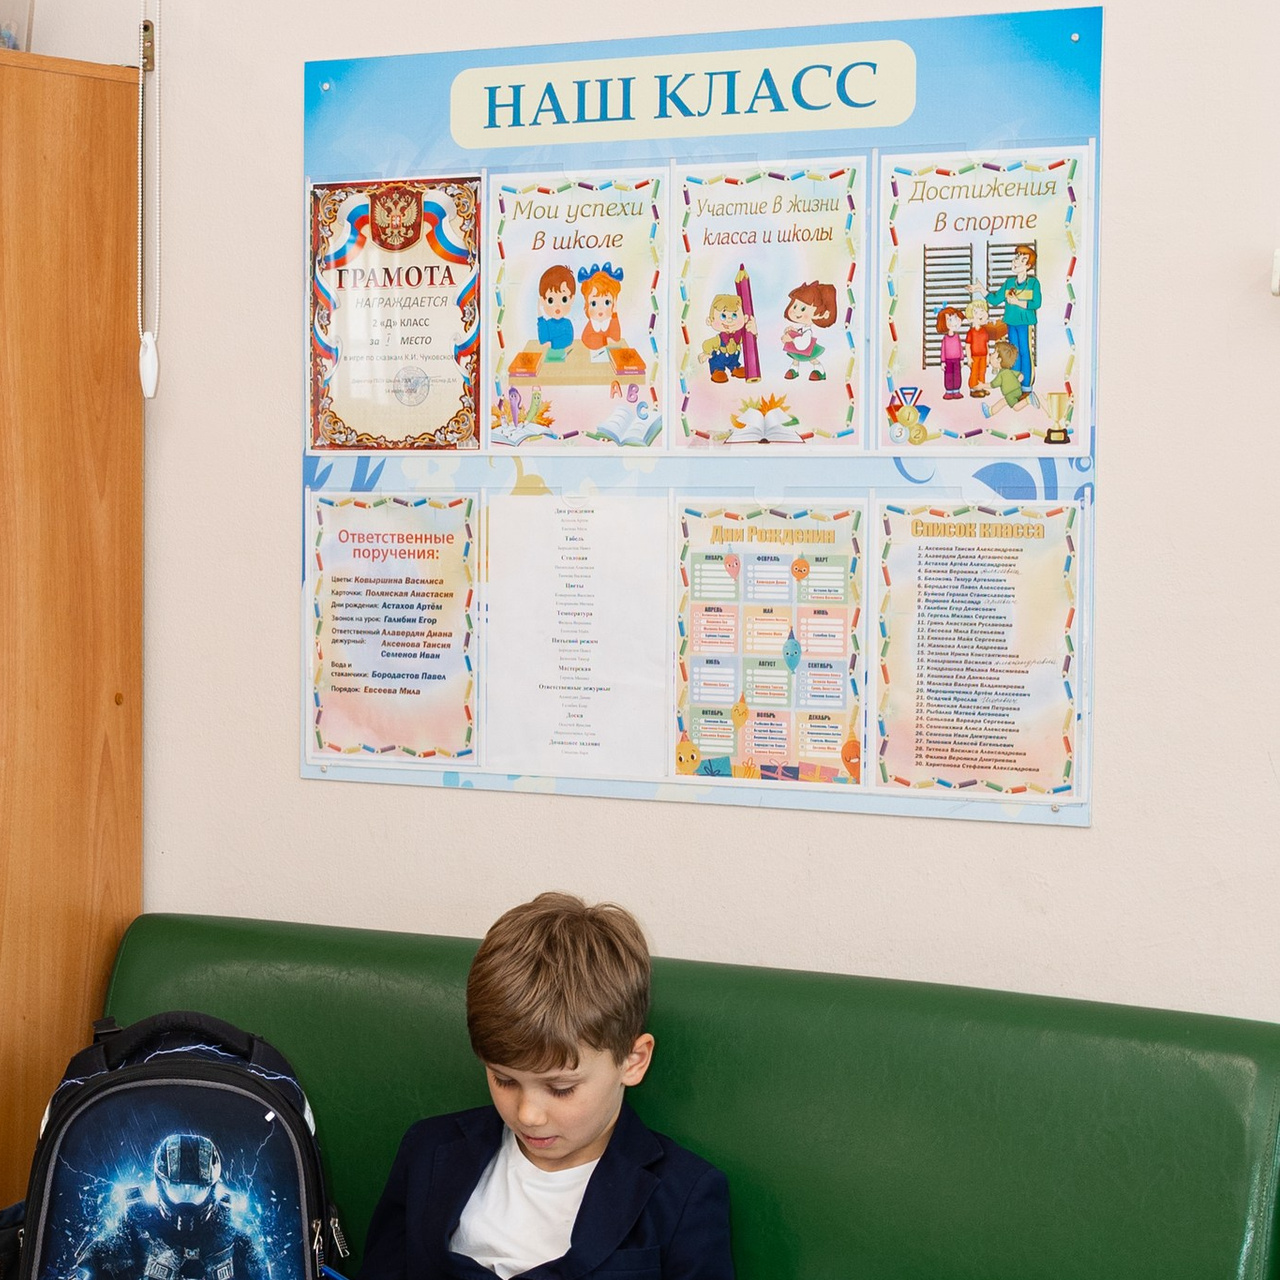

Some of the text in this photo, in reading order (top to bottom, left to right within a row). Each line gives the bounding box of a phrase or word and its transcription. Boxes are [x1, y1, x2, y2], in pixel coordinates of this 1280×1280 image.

[483, 61, 877, 129] НАШ КЛАСС
[908, 179, 1056, 204] Достижения
[512, 200, 643, 223] Мои успехи
[697, 198, 766, 217] Участие
[786, 195, 839, 213] жизни
[954, 213, 1037, 235] спорте
[553, 230, 623, 250] школе
[703, 223, 833, 245] класса и школы
[337, 265, 457, 289] ГРАМОТА
[355, 296, 448, 309] НАГРАЖДАЕТСЯ
[400, 318, 429, 328] КЛАСС
[400, 336, 432, 345] МЕСТО
[711, 525, 835, 544] Дни Рождения
[911, 519, 1045, 539] Список класса
[338, 529, 454, 544] Ответственные
[353, 549, 439, 562] поручения:
[354, 577, 403, 585] Ковыршина
[405, 577, 444, 585] Василиса
[365, 590, 408, 598] Полянская
[410, 591, 453, 599] Анастасия
[381, 602, 414, 610] Астахов
[416, 602, 442, 611] Артём
[384, 616, 416, 624] Галибин
[418, 617, 437, 625] Егор
[381, 629, 424, 638] Алавердян
[426, 630, 452, 639] Диана
[381, 640, 420, 648] Аксенова
[422, 641, 451, 649] Таисия
[381, 651, 417, 659] Семенов
[372, 671, 419, 680] Бородастов
[422, 672, 446, 680] Павел
[364, 686, 397, 695] Евсеева
[399, 687, 421, 695] Мила
